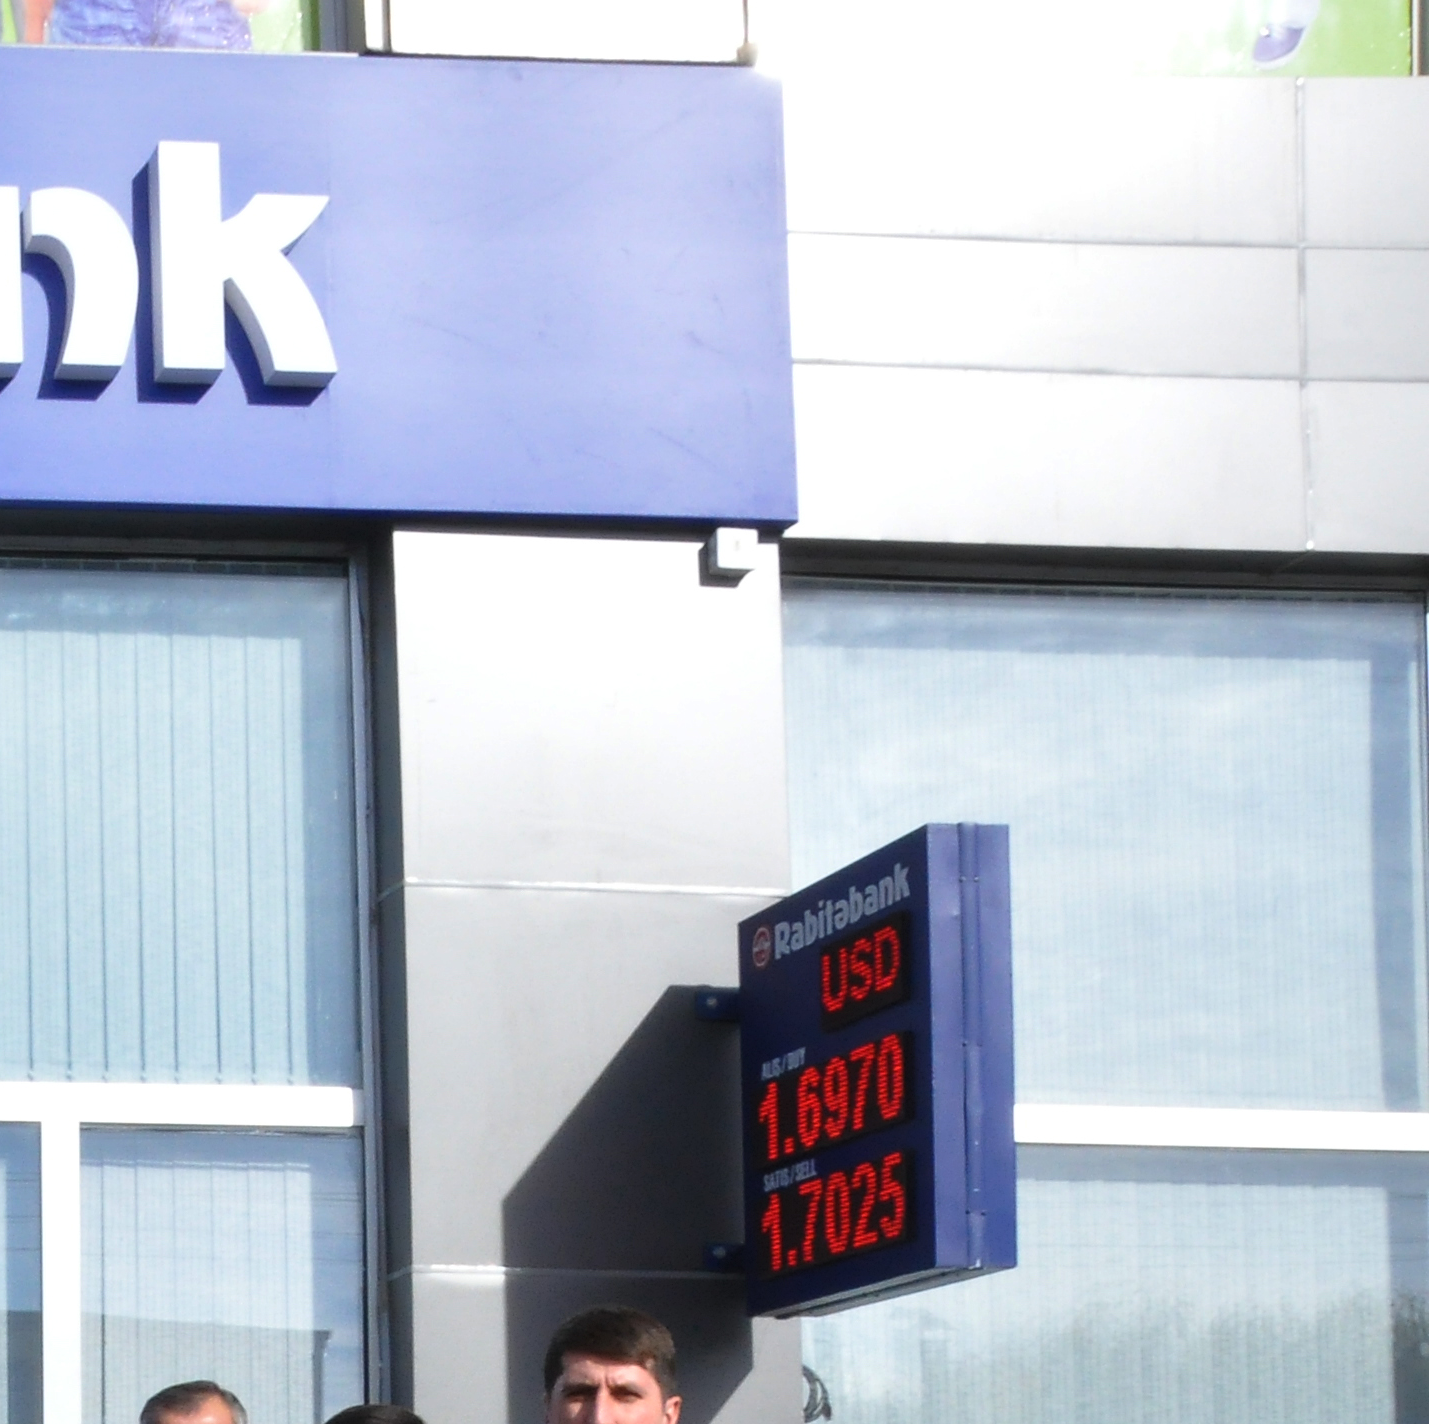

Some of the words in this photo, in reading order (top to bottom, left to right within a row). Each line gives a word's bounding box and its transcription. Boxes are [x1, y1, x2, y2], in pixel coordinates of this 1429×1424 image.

[821, 925, 901, 1012] USD
[758, 1034, 904, 1160] 1.6970
[761, 1152, 905, 1270] 1.7025
